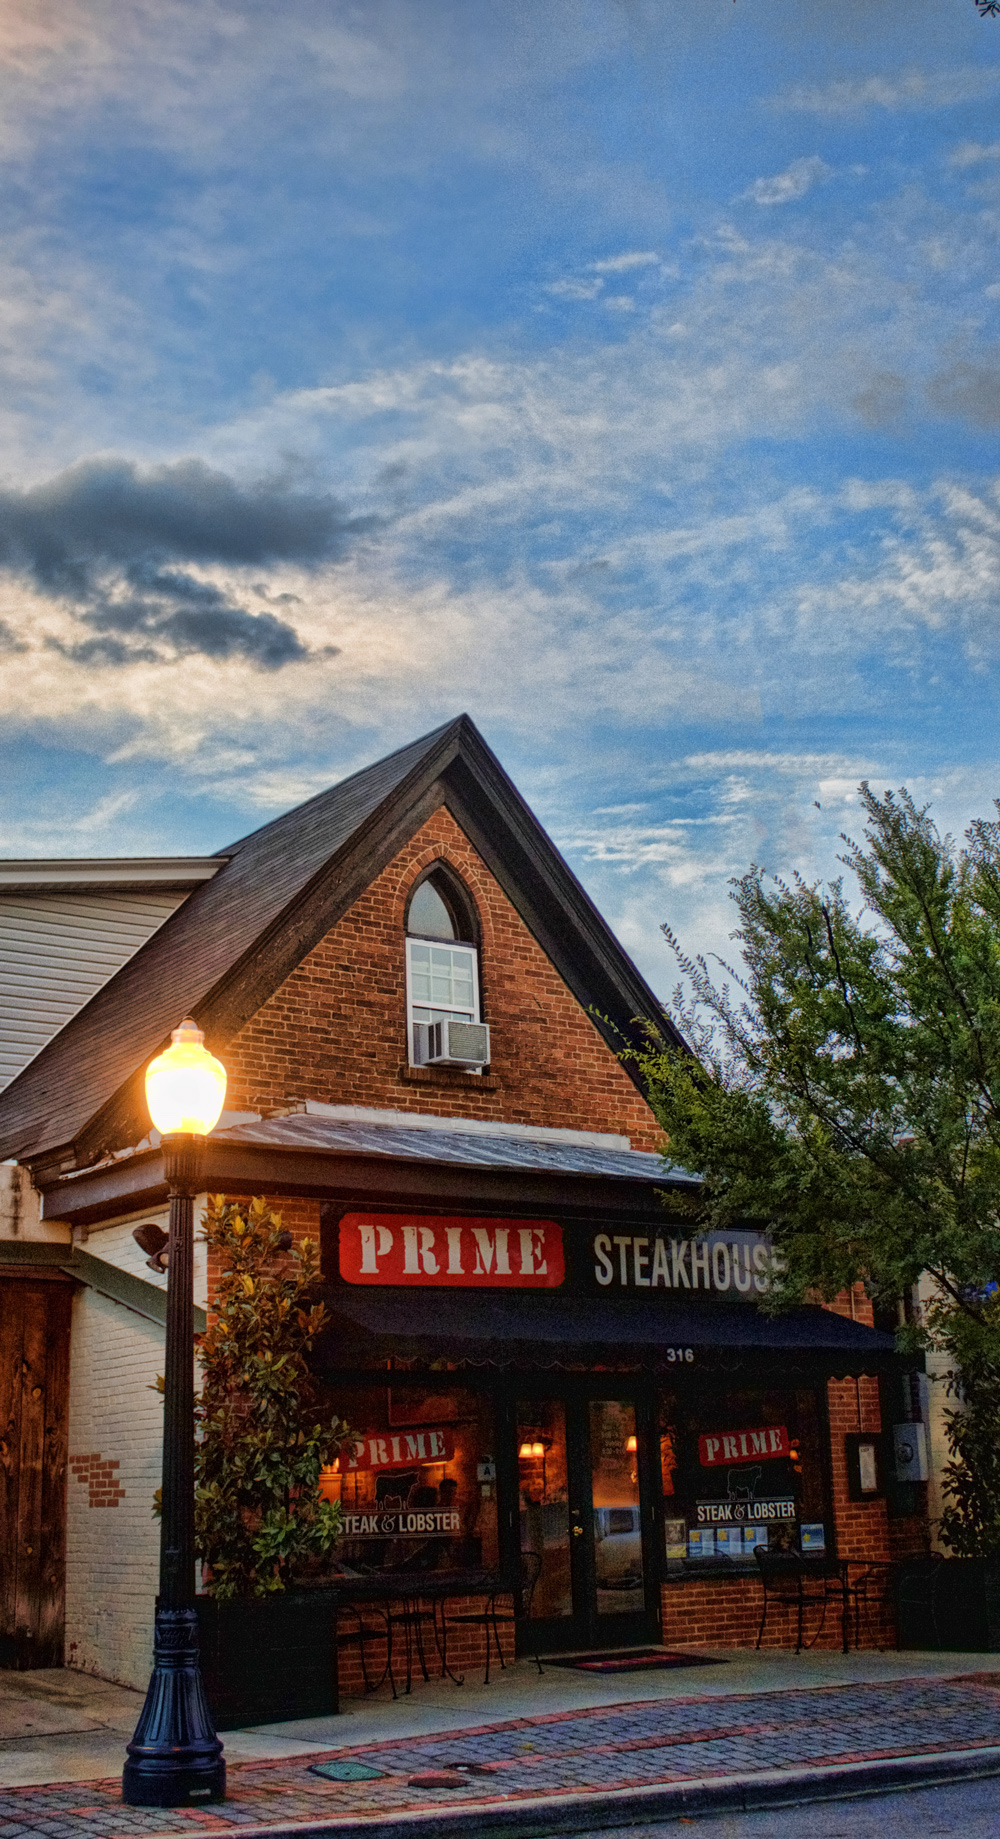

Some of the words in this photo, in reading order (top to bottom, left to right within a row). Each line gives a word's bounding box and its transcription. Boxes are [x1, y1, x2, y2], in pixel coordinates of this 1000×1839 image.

[358, 1225, 548, 1276] PRIME
[594, 1234, 787, 1293] STEAKHOUSE
[666, 1348, 694, 1363] 316
[347, 1431, 446, 1468] PRIME
[705, 1429, 783, 1462] PRIME
[483, 1466, 491, 1476] A
[381, 1515, 397, 1533] &
[399, 1512, 460, 1533] LOBSTER
[697, 1504, 733, 1522] STEAK
[733, 1503, 745, 1520] &
[748, 1501, 796, 1520] LOBSTER
